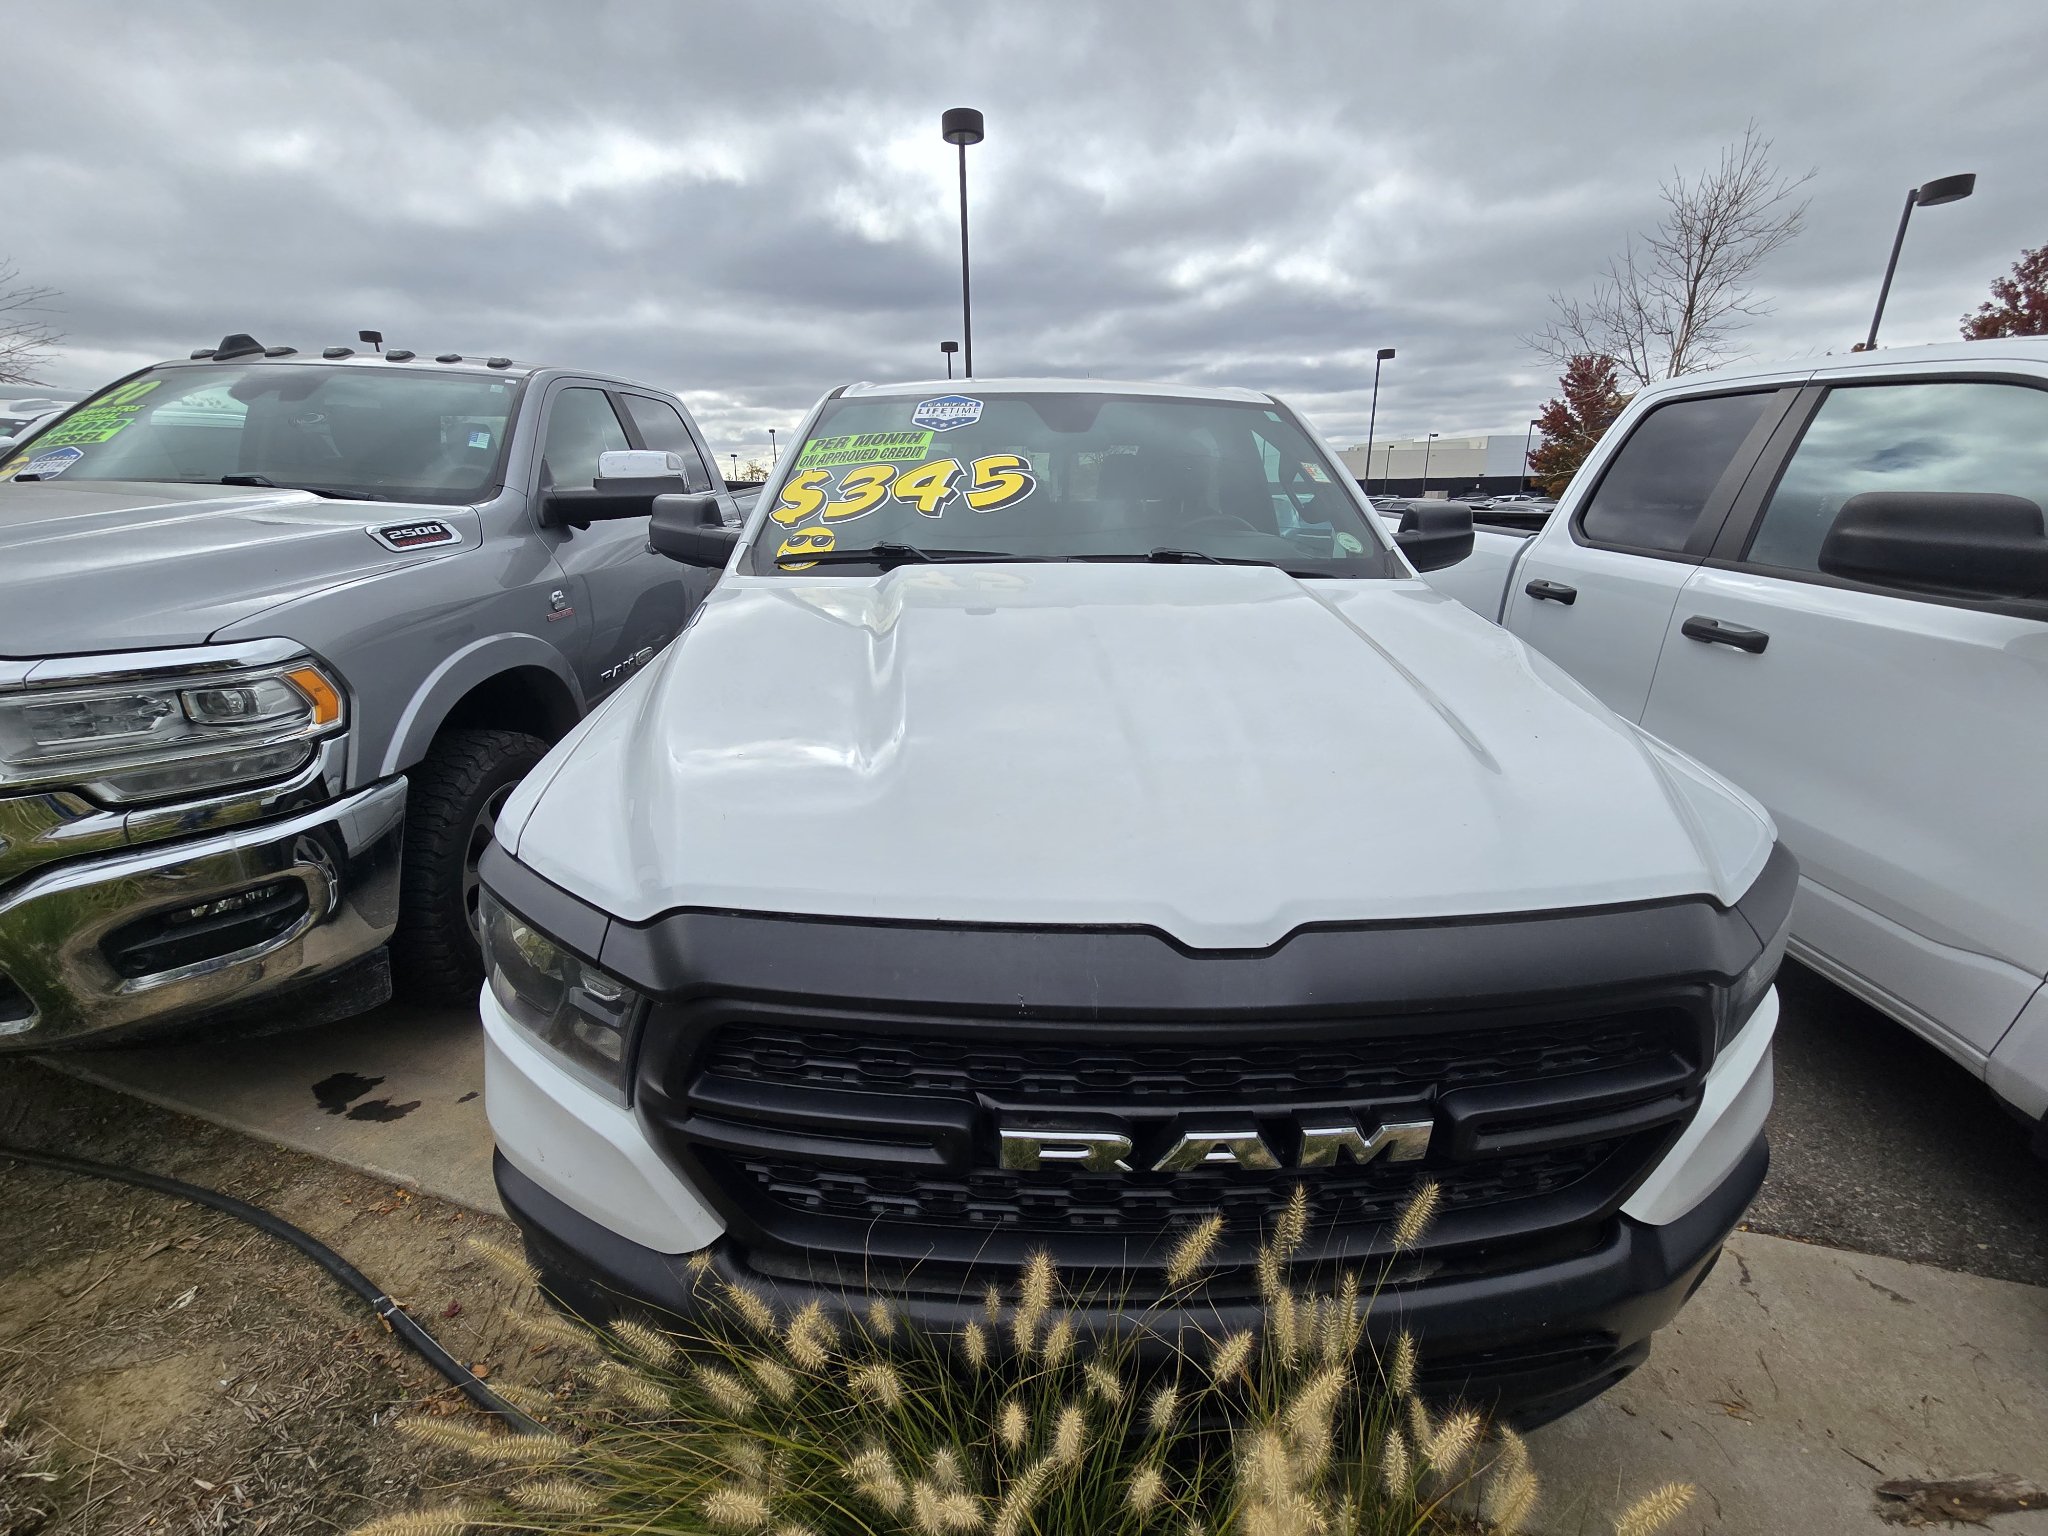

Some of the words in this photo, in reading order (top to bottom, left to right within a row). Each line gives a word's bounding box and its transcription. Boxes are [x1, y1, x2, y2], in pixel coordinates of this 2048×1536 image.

[88, 380, 162, 408] 20
[917, 407, 980, 415] LIFETIME
[810, 436, 850, 453] PER
[852, 432, 926, 448] MONTH
[799, 455, 818, 468] ON
[816, 448, 881, 466] APPROVED
[880, 446, 927, 460] CREDIT
[768, 453, 1037, 530] $345
[386, 525, 442, 541] 2500
[999, 1119, 1435, 1172] RAM
